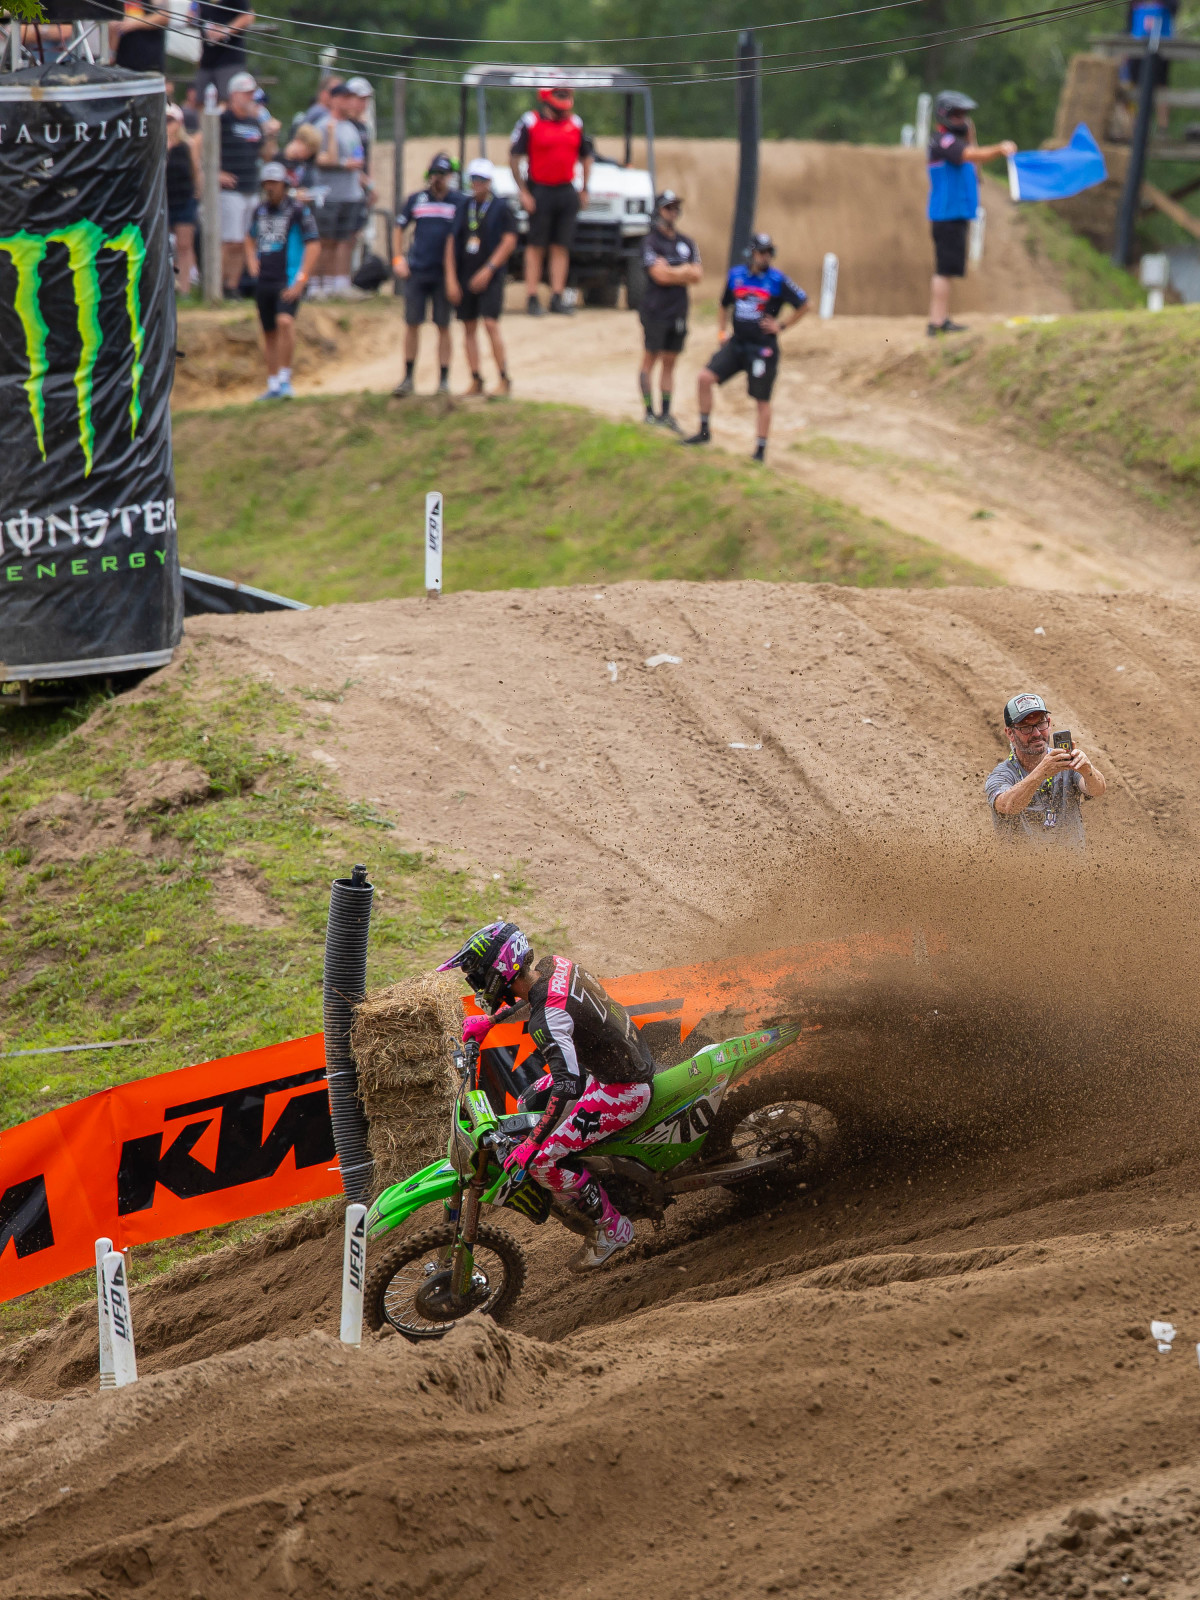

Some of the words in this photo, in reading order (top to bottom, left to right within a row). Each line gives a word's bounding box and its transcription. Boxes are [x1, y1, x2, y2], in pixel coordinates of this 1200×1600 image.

[0, 498, 177, 557] ONSTER
[7, 549, 167, 582] ENERGY
[551, 957, 571, 996] PRADO
[117, 1066, 338, 1217] KTM
[664, 1098, 715, 1143] 70
[349, 1238, 361, 1291] UFO
[110, 1287, 127, 1340] UFO
